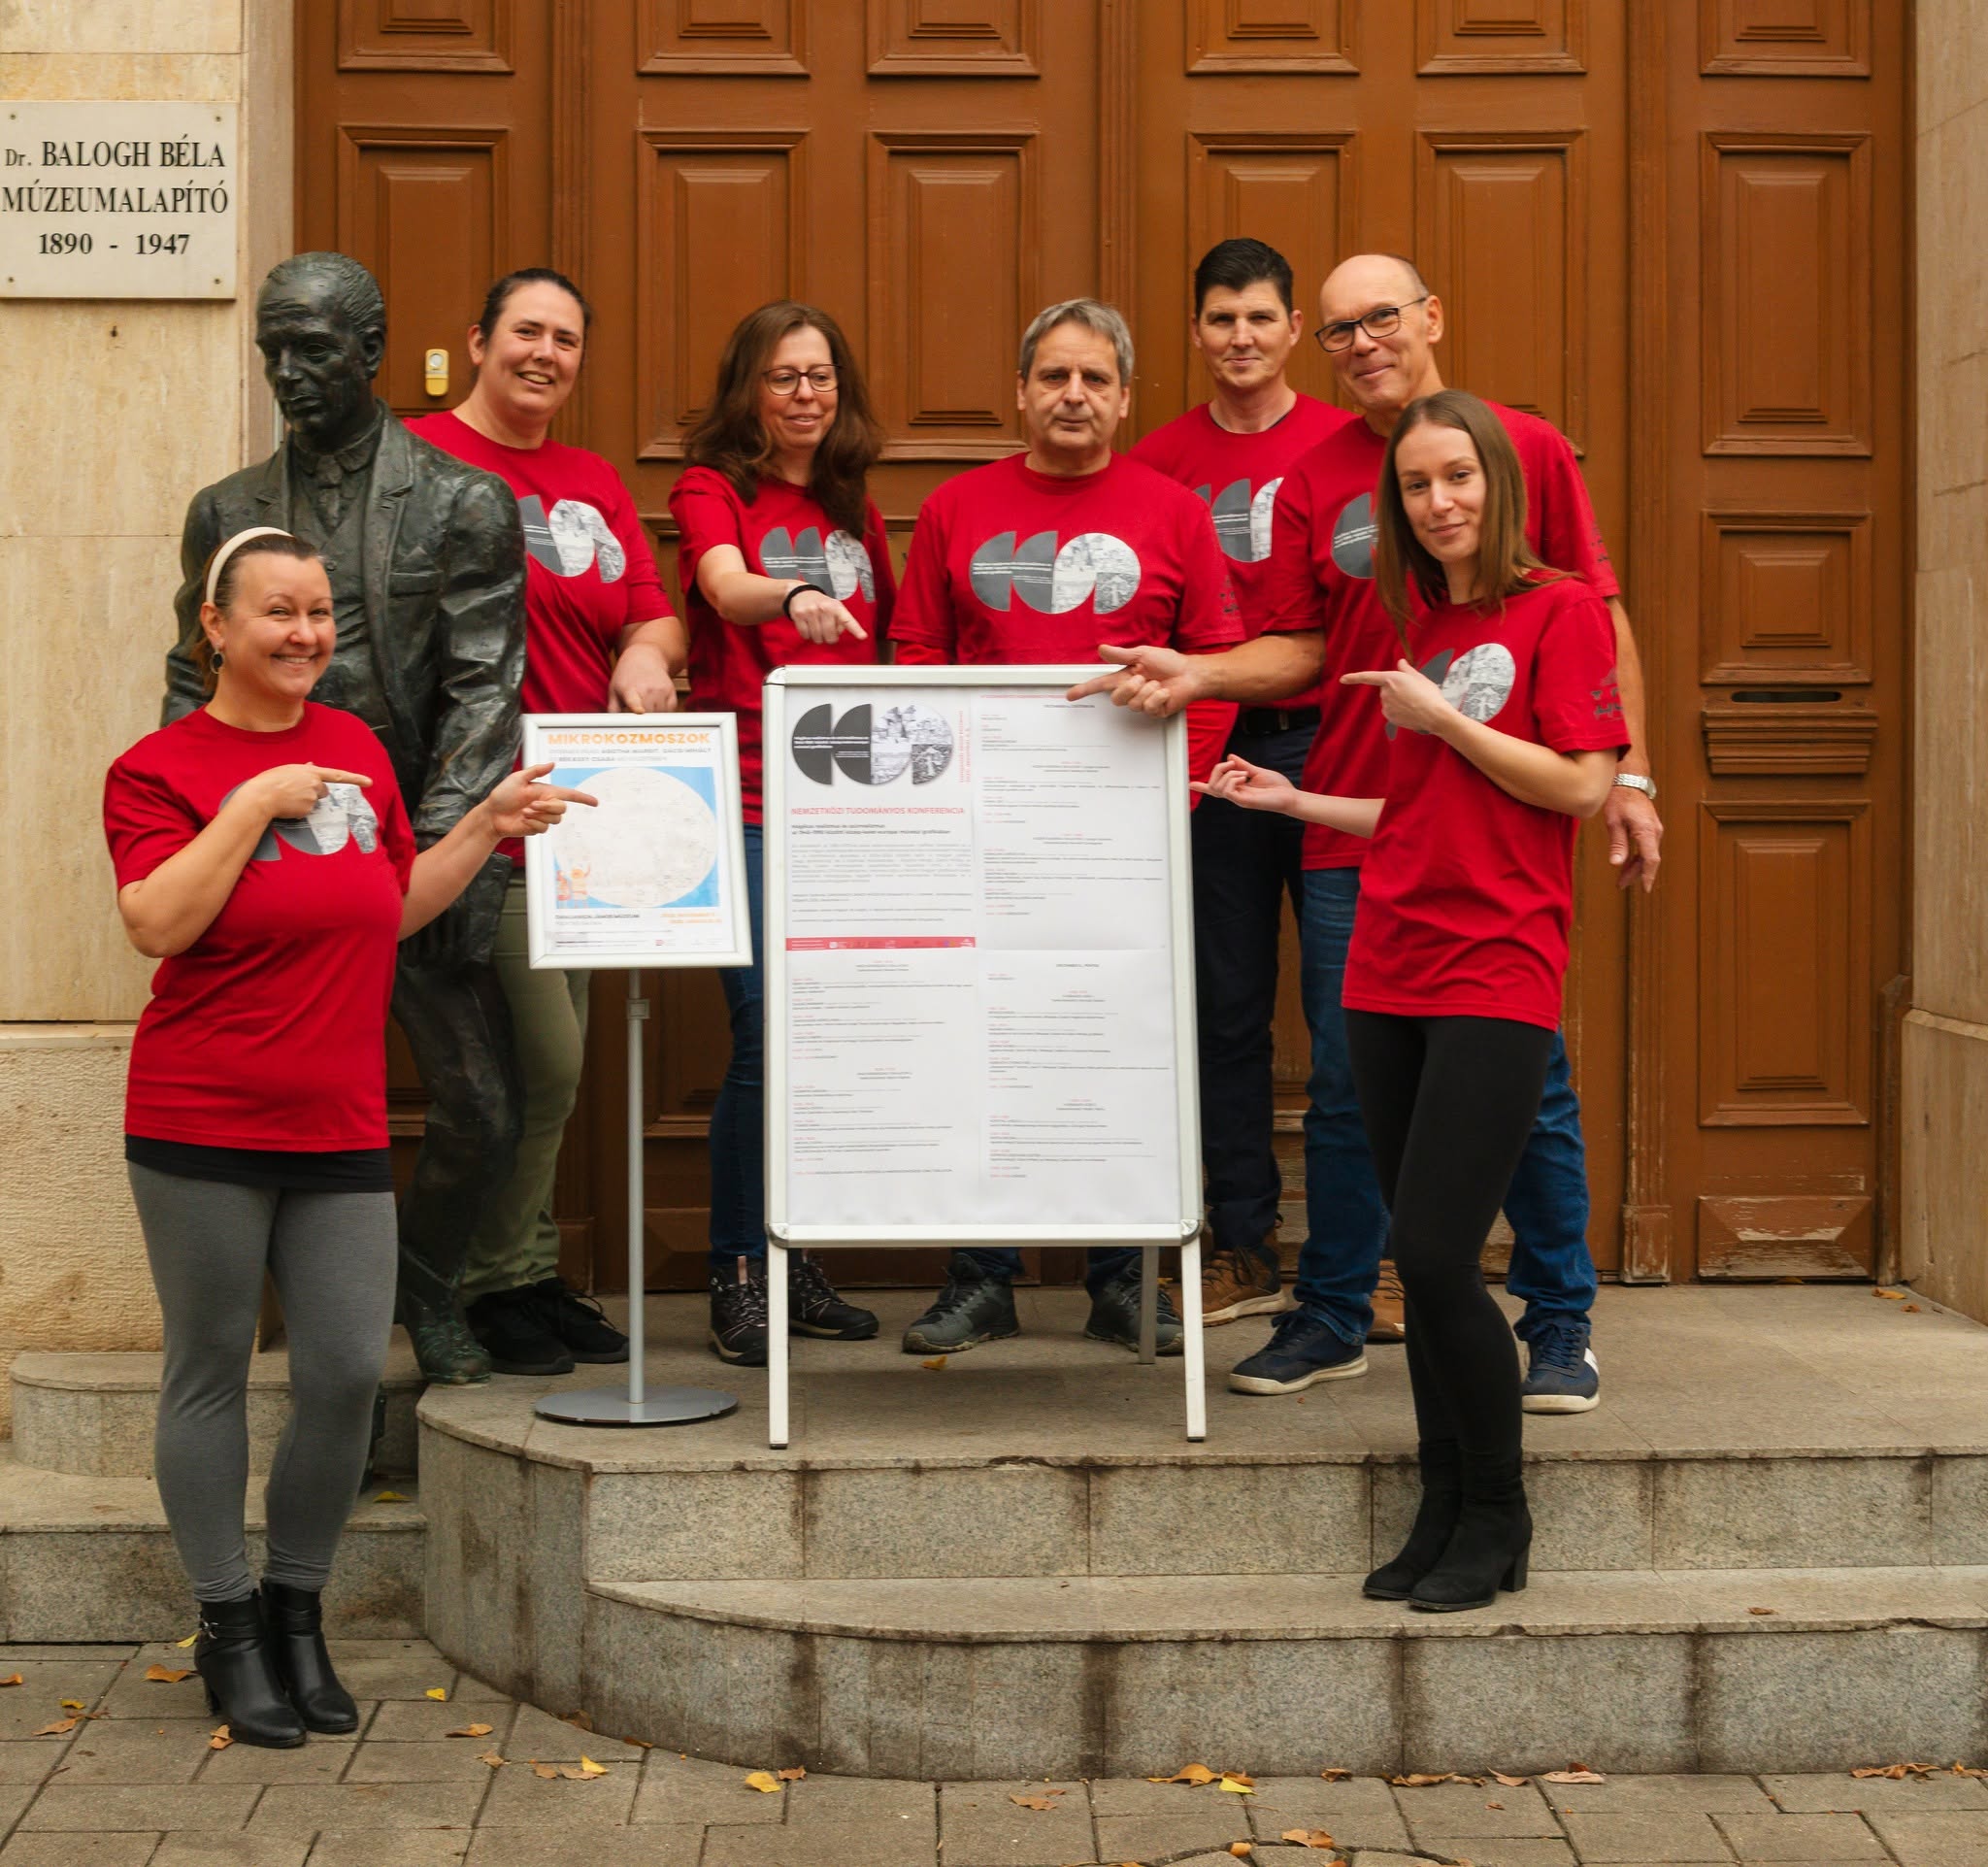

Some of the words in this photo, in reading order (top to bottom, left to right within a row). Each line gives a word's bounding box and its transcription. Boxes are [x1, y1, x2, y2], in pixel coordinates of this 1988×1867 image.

[5, 149, 32, 167] Dr.
[41, 141, 150, 167] BALOGH
[159, 134, 226, 167] BÉLA
[1, 179, 229, 214] MÚZEUMALAPÍTÓ
[39, 233, 92, 254] 1890
[136, 234, 190, 254] 1947
[547, 733, 711, 745] MIKROKOZMOSZOK
